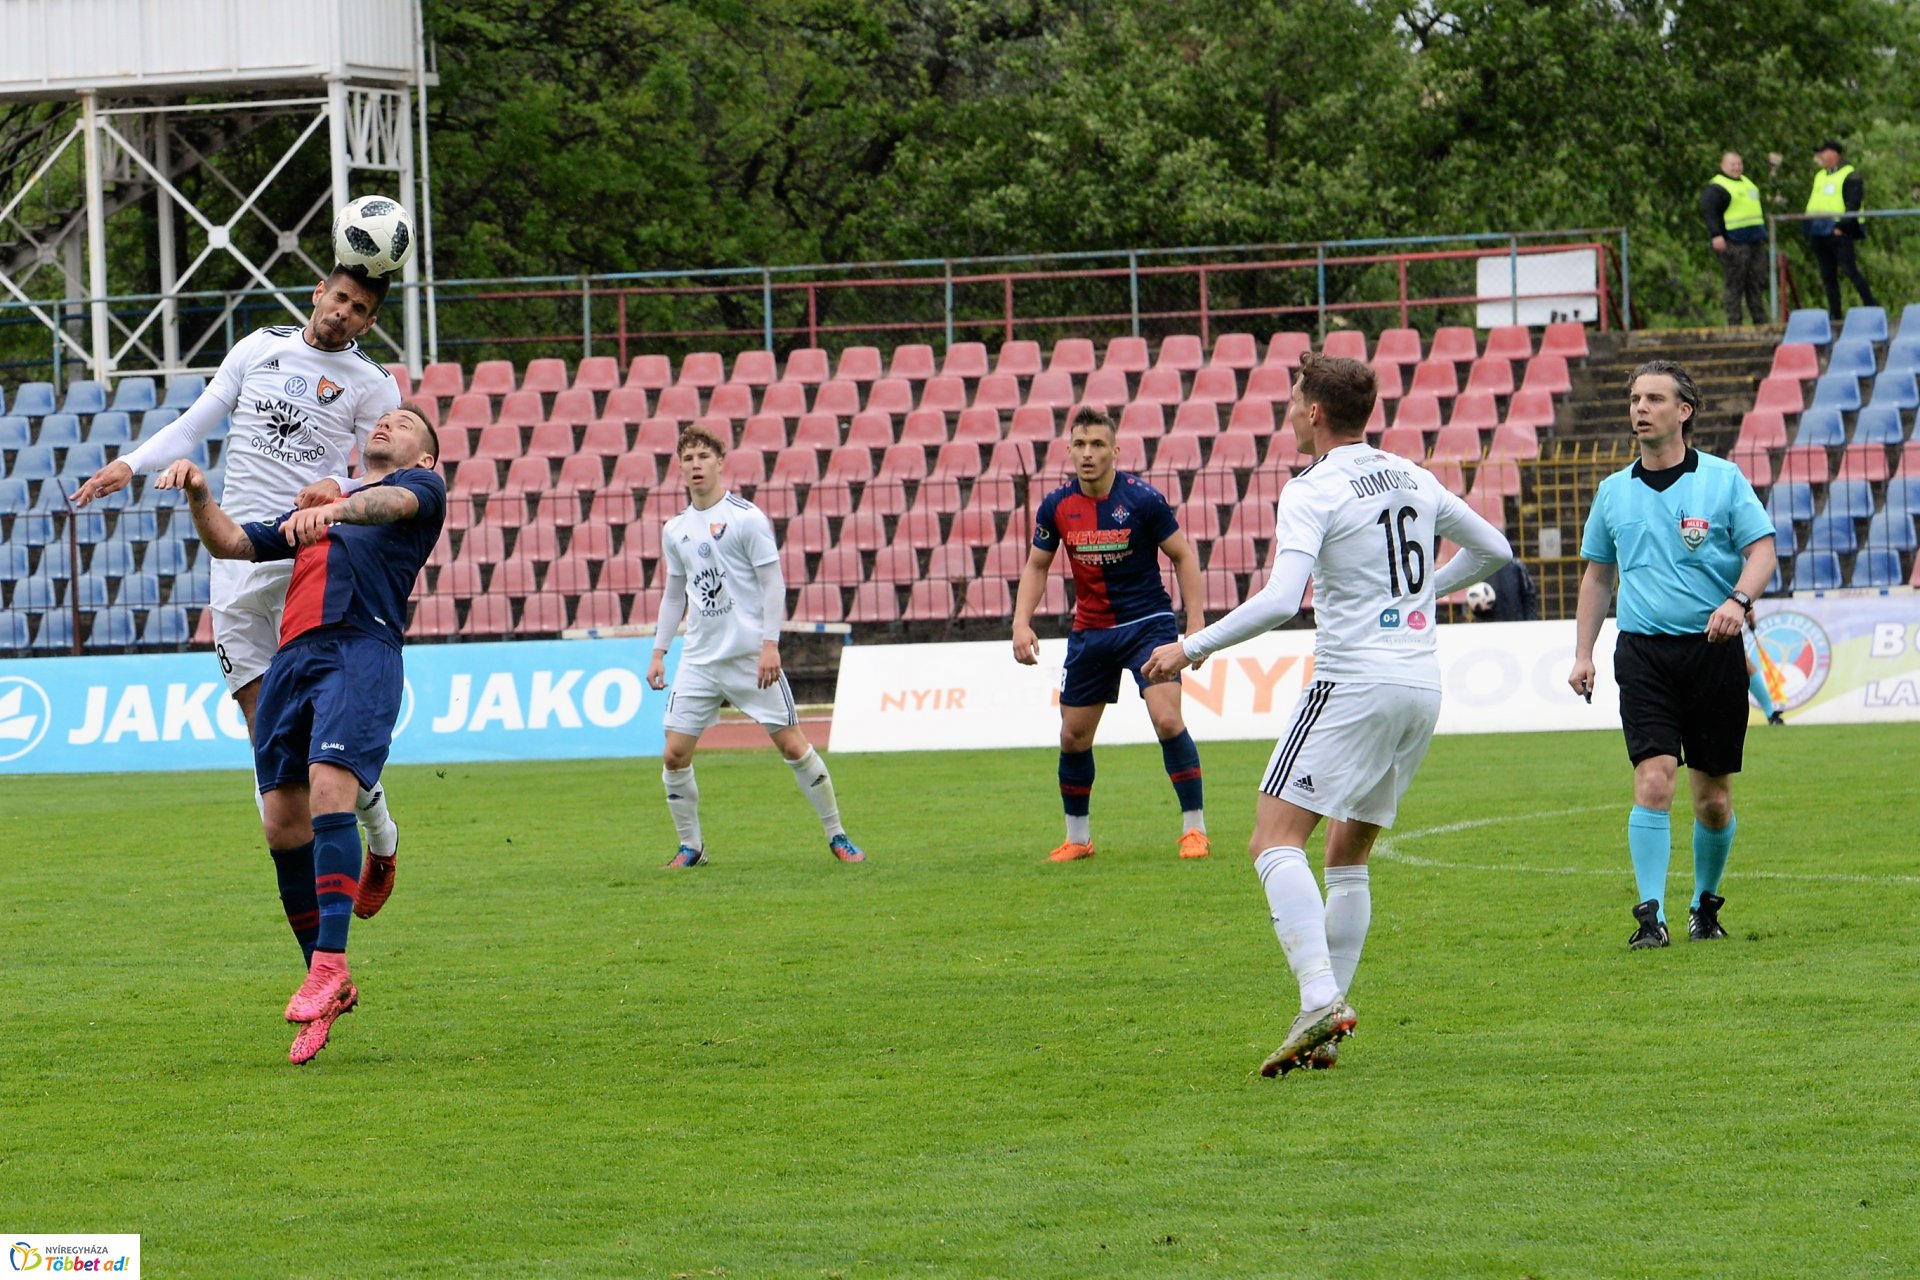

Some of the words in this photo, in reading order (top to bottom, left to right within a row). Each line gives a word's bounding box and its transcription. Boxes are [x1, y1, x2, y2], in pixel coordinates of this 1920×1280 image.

[1376, 505, 1425, 598] 16
[1869, 621, 1920, 657] B
[432, 668, 643, 734] JAKO
